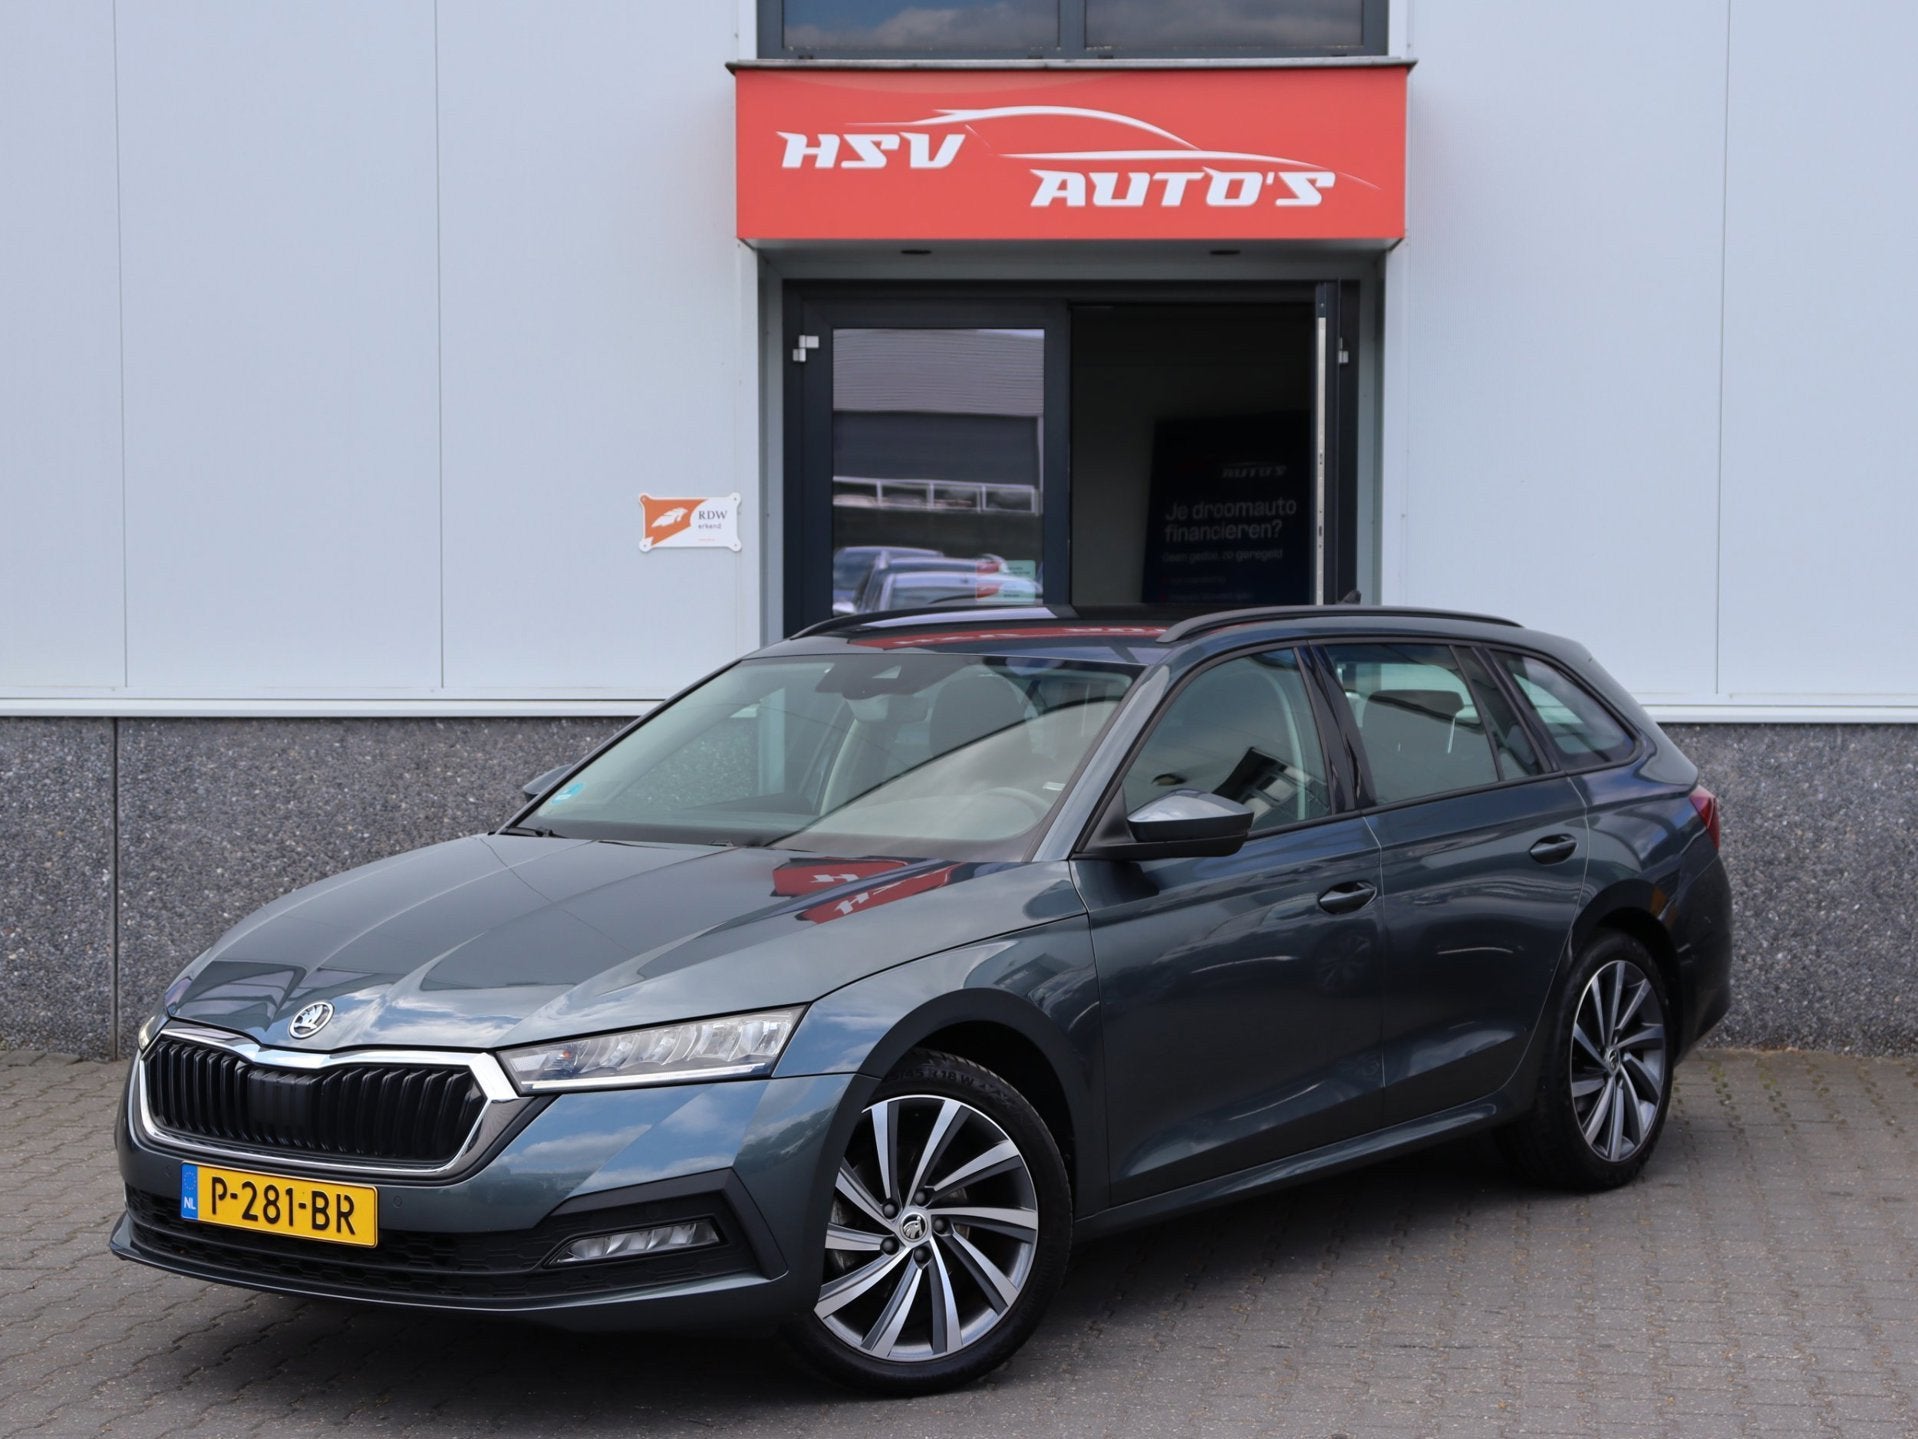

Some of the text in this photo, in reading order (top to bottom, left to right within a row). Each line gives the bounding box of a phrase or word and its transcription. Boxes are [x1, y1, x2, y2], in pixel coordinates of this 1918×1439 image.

[775, 130, 966, 169] HSV
[1029, 166, 1336, 207] AUTO'S
[698, 510, 727, 520] RDW
[1165, 497, 1297, 521] Je droomauto
[1164, 519, 1283, 542] financieren?
[184, 1196, 196, 1210] NL
[211, 1176, 356, 1235] P-281-BR
